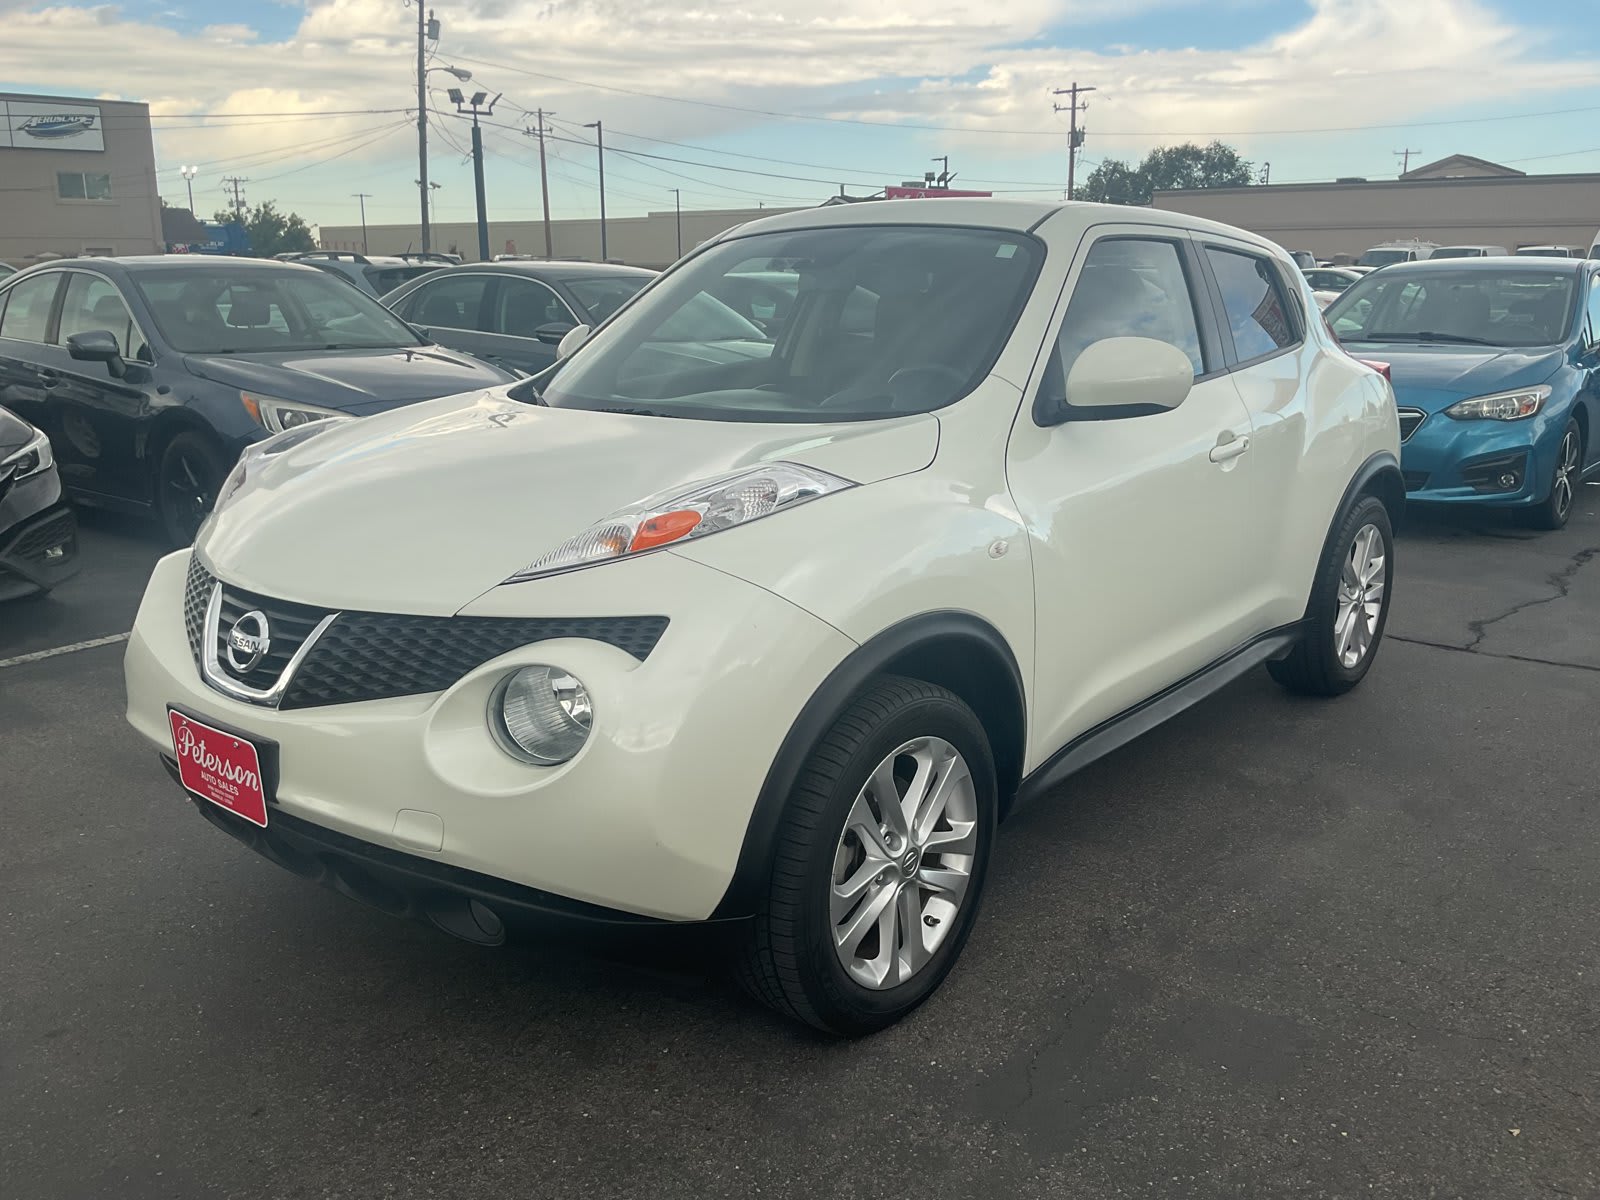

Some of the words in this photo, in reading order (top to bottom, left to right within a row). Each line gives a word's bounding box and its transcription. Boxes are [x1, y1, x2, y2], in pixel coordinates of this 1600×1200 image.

[178, 726, 259, 791] Peterson
[201, 770, 217, 786] AUTO
[217, 779, 239, 796] SALES
